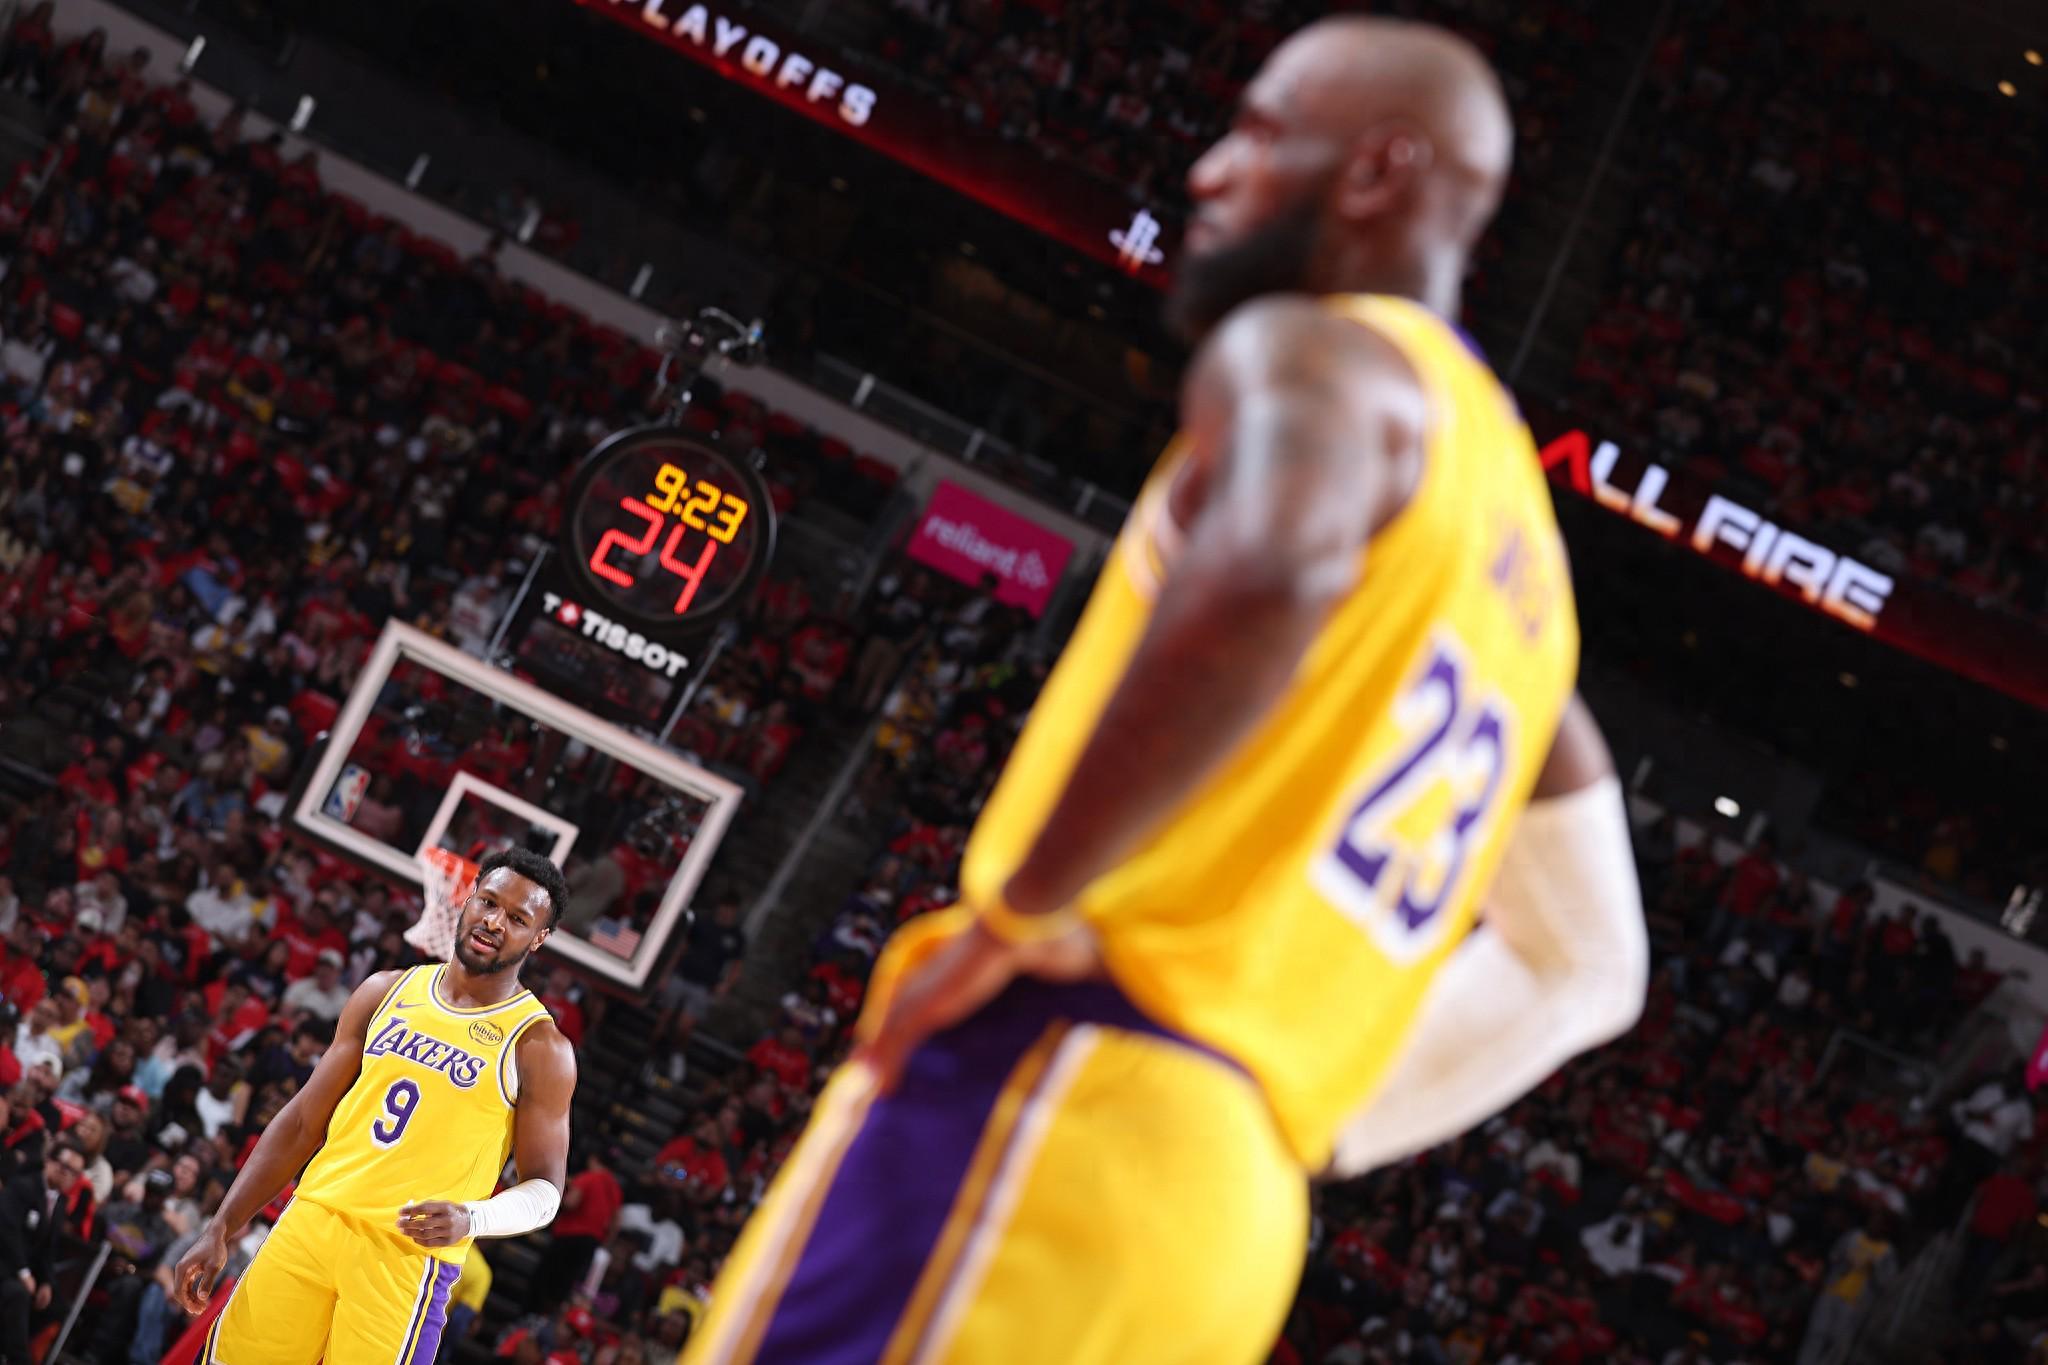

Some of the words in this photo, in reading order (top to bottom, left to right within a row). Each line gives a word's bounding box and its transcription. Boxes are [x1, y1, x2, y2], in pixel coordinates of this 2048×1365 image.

[609, 0, 877, 126] LAYOFFS
[646, 462, 748, 544] 9:23
[1538, 429, 1682, 539] ALL
[1691, 494, 1894, 633] FIRE
[590, 496, 718, 615] 24
[924, 515, 1018, 579] reliant
[582, 608, 689, 678] TISSOT
[1310, 630, 1514, 960] 23
[364, 1015, 488, 1089] LAKERS
[473, 1022, 502, 1042] bibigo
[372, 1078, 421, 1149] 9
